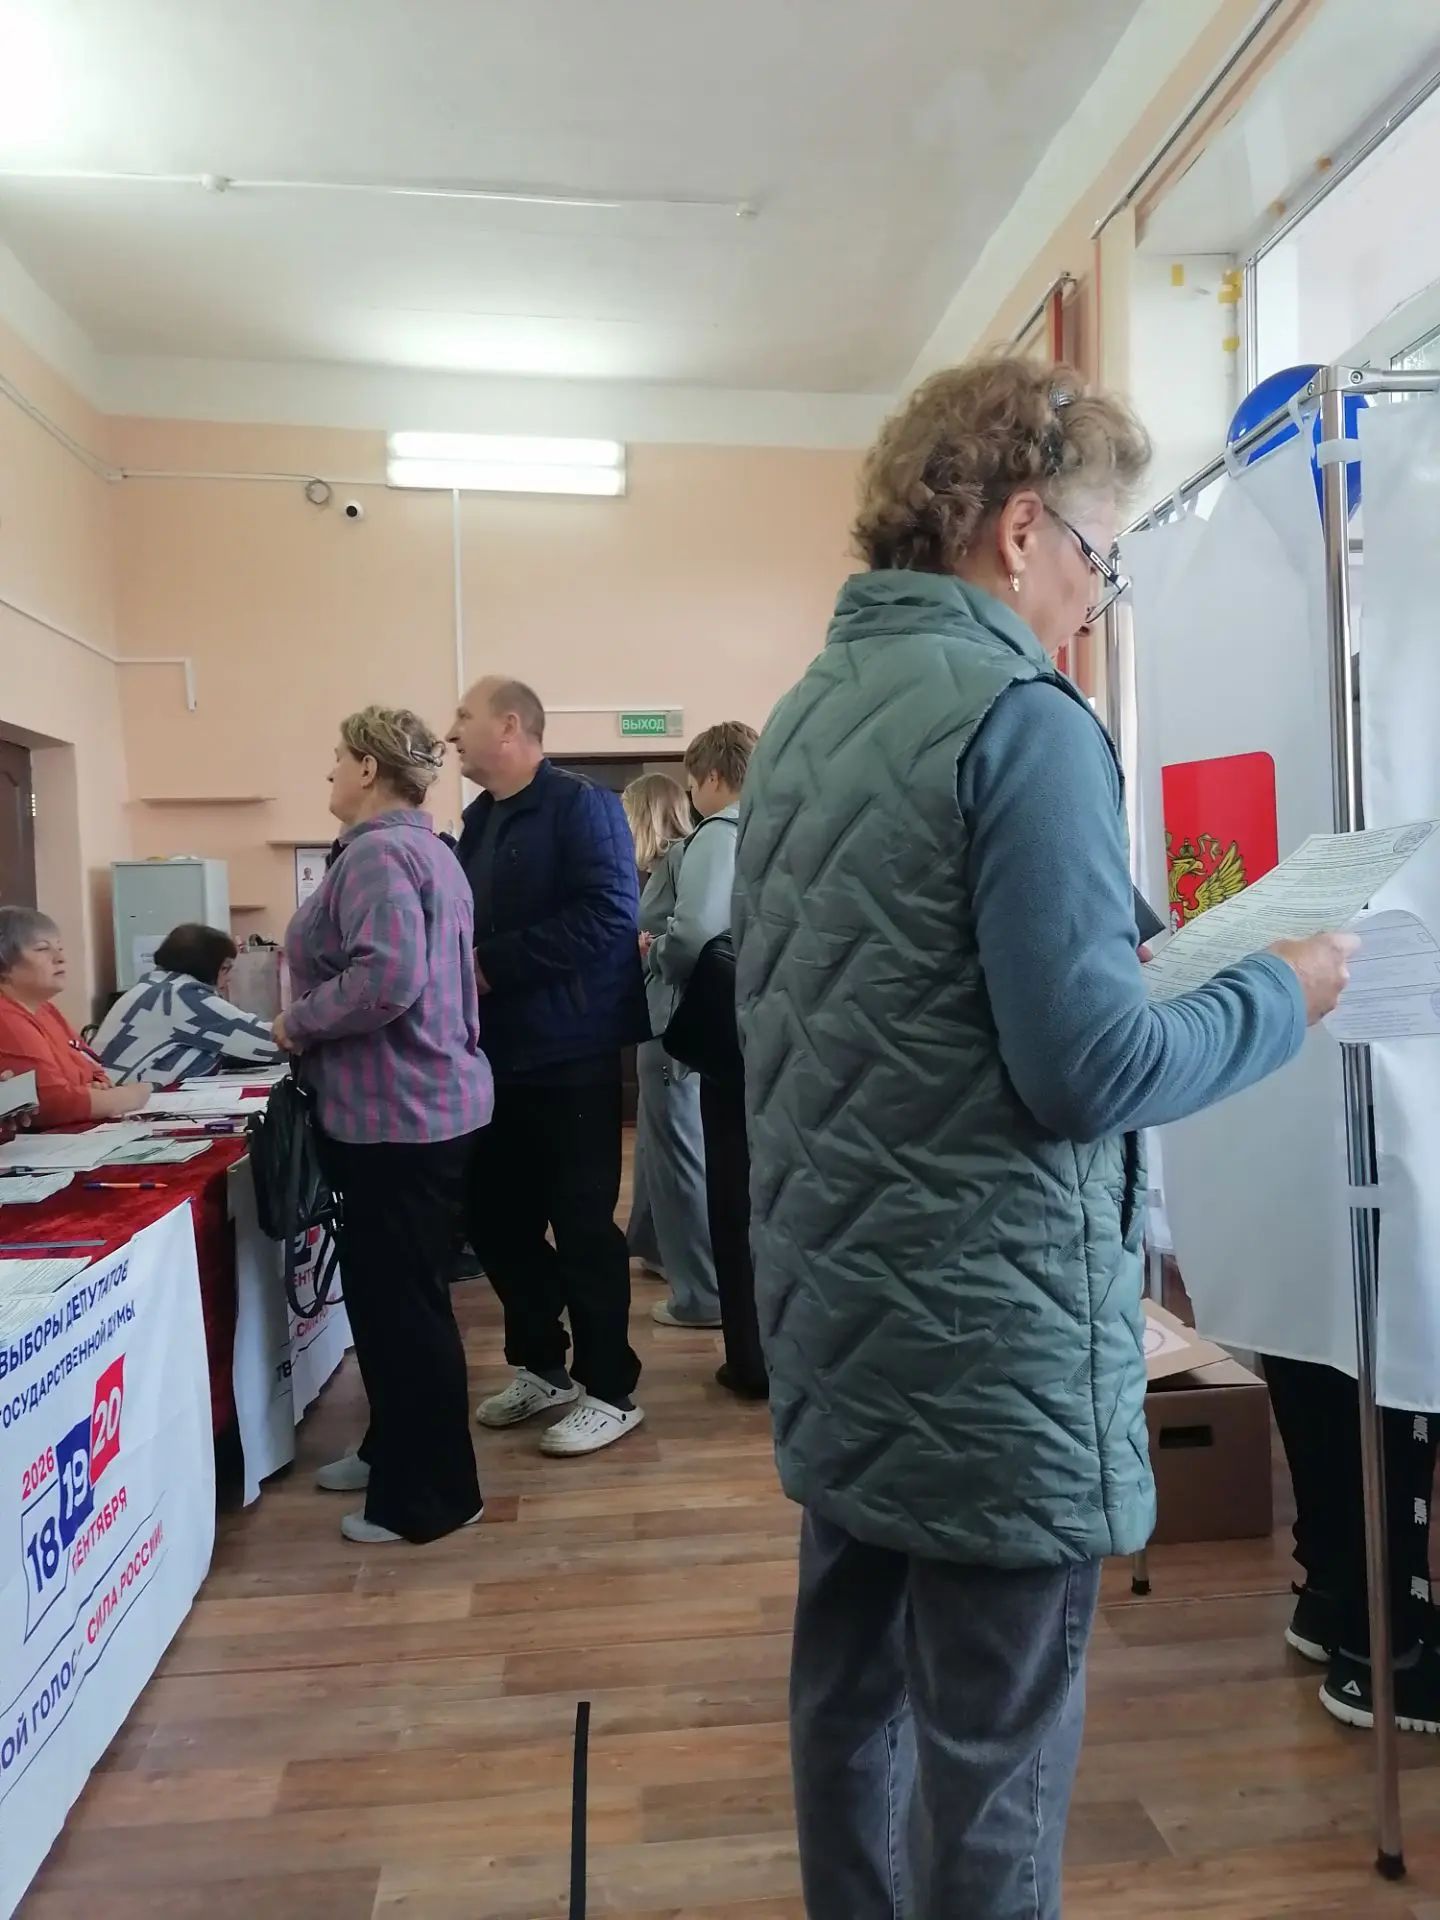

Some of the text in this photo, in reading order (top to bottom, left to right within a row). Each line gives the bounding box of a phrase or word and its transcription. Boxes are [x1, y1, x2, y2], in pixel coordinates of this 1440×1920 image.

[622, 718, 665, 732] ВЫХОД
[0, 1308, 63, 1380] ВЫБОРЫ
[65, 1258, 129, 1333] ДЕПУТАТОВ
[0, 1319, 106, 1429] ОСУДАРСТВЕННОЙ
[91, 1386, 122, 1460] 20
[22, 1445, 55, 1501] 2026
[62, 1448, 88, 1521] 19
[26, 1515, 60, 1594] 18
[0, 1711, 29, 1778] ОЙ
[86, 1585, 118, 1645] СИЛА
